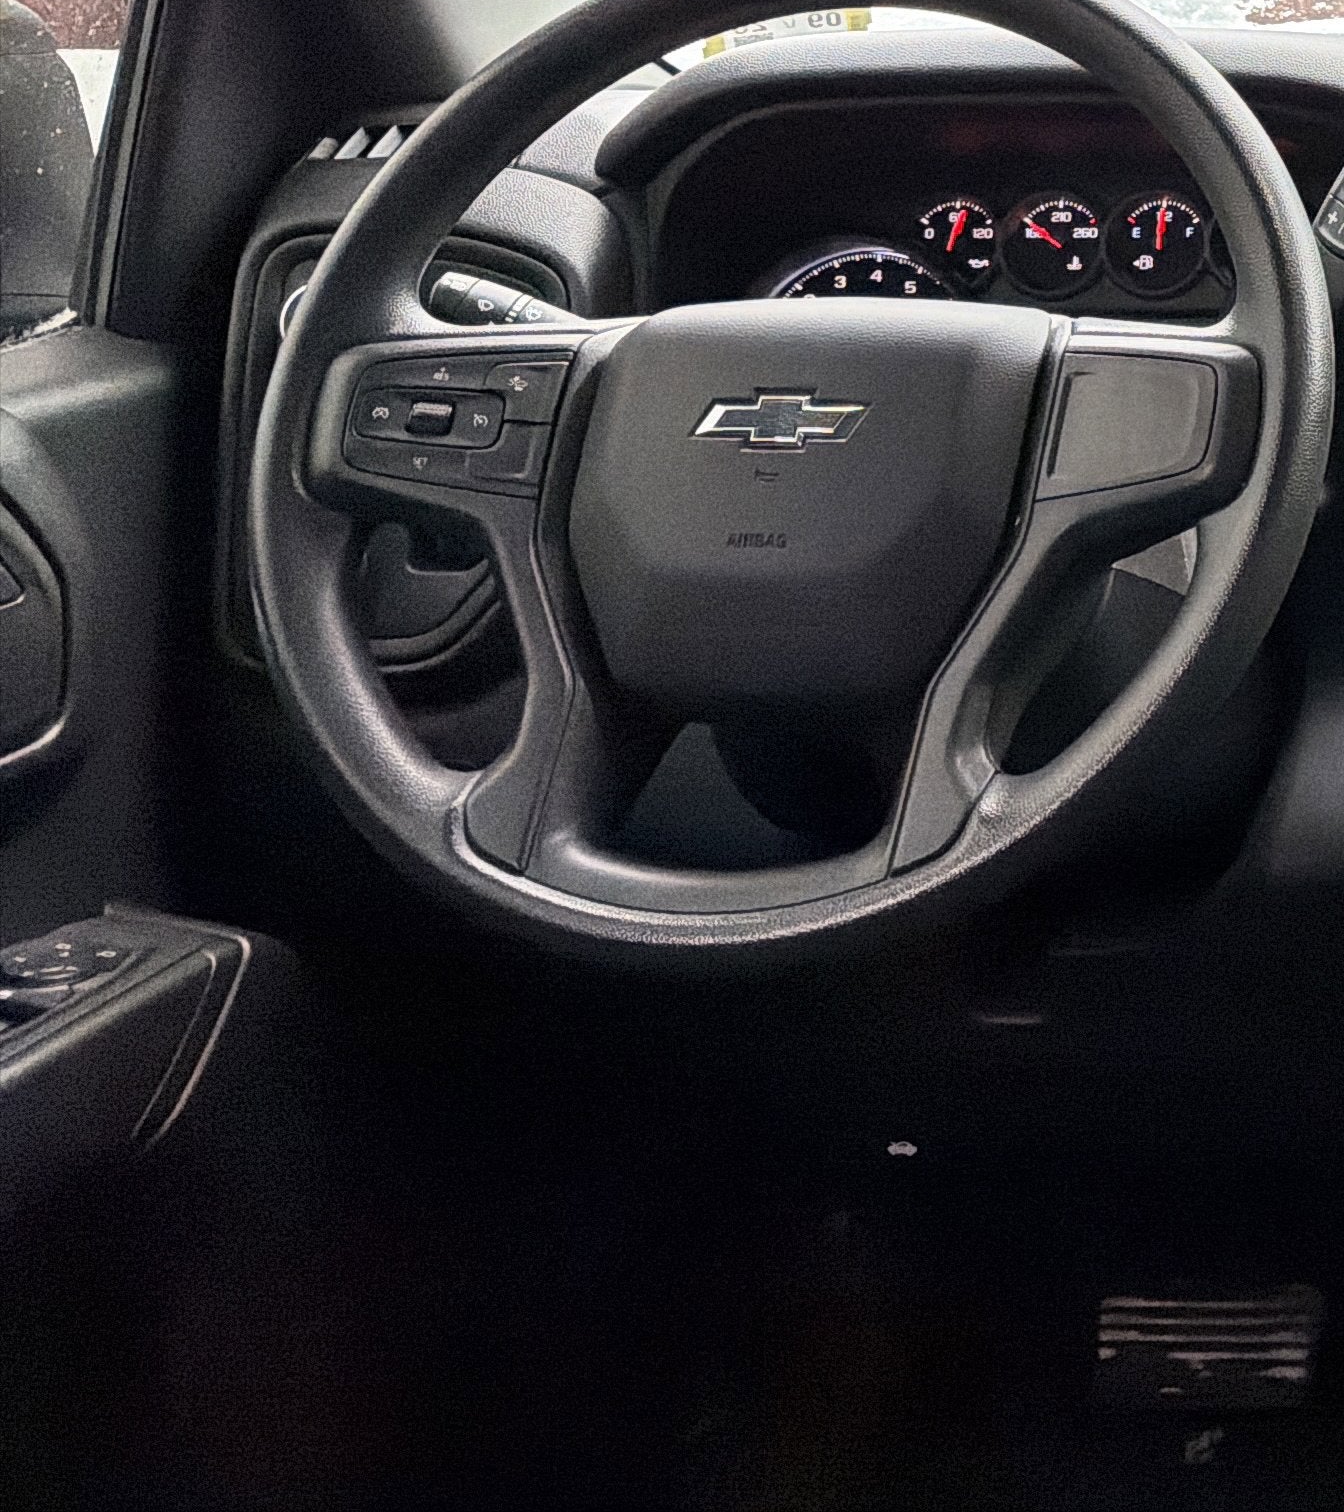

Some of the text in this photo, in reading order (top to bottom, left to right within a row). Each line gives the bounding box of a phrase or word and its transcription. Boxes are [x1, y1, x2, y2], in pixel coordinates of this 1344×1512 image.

[1051, 211, 1072, 223] 210
[924, 227, 935, 239] 0
[972, 227, 993, 239] 120
[1072, 227, 1098, 239] 260
[1131, 227, 1141, 239] E
[1186, 226, 1195, 238] F
[833, 274, 847, 289] 3
[870, 268, 883, 283] 4
[904, 280, 917, 294] 5
[726, 533, 787, 549] AIRBAG
